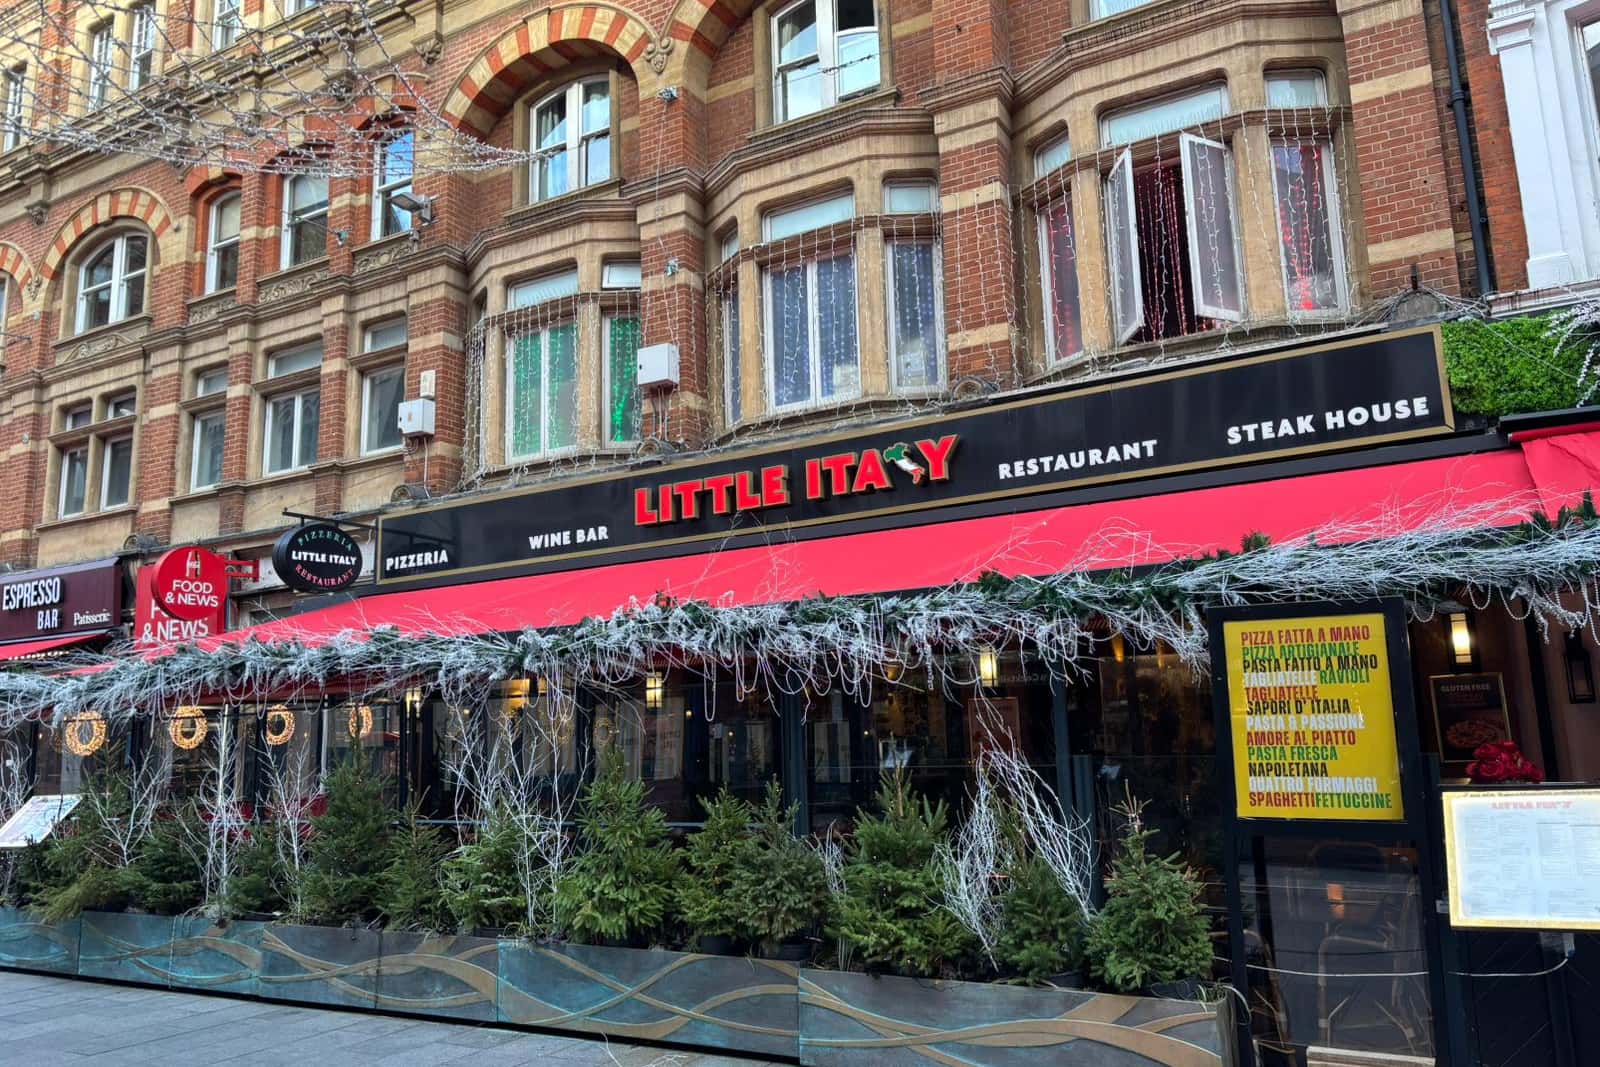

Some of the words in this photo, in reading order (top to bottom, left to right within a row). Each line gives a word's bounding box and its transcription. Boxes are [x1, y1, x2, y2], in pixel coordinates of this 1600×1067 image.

[1227, 414, 1315, 445] STEAK
[1324, 396, 1429, 430] HOUSE
[998, 439, 1158, 480] RESTAURANT
[634, 464, 790, 526] LITTLE
[297, 529, 352, 552] PIZZERIA
[528, 530, 571, 550] WINE
[576, 526, 609, 544] BAR
[291, 550, 327, 563] LITTLE
[328, 554, 357, 566] ITALY
[386, 550, 449, 571] PIZZERIA
[295, 563, 354, 587] RESTAURANT
[2, 576, 61, 611] ESPRESSO
[172, 579, 214, 594] FOOD
[165, 591, 175, 604] &
[177, 593, 219, 608] NEWS
[37, 608, 59, 631] BAR
[73, 608, 112, 626] Patisserie
[142, 622, 154, 643] &
[157, 616, 209, 641] NEWS
[1241, 630, 1275, 646] PIZZA
[1278, 628, 1314, 644] FATTA
[1318, 627, 1326, 642] A
[1329, 625, 1370, 642] MANO
[1242, 644, 1276, 660] PIZZA
[1280, 641, 1360, 659] ARTIGIANALE
[1243, 657, 1281, 673] PASTA
[1285, 655, 1321, 672] FATTO
[1325, 655, 1333, 670] A
[1337, 653, 1378, 670] MANO
[1244, 671, 1317, 687] TAGLIATELLE
[1319, 668, 1370, 684] RAVIOLI
[1245, 684, 1319, 700] TAGLIATELLE
[1247, 699, 1291, 715] SAPORI
[1247, 714, 1285, 731] PASTA
[1301, 713, 1365, 730] PASSIONE
[1247, 730, 1290, 746] AMORE
[1294, 730, 1308, 746] AL
[1311, 729, 1357, 746] PIATTO
[1247, 746, 1287, 761] PASTA
[1290, 745, 1338, 761] FRESCA
[1248, 762, 1328, 777] NAPOLETANA
[1249, 776, 1304, 792] QUATTRO
[1307, 776, 1378, 793] FORMAGGI
